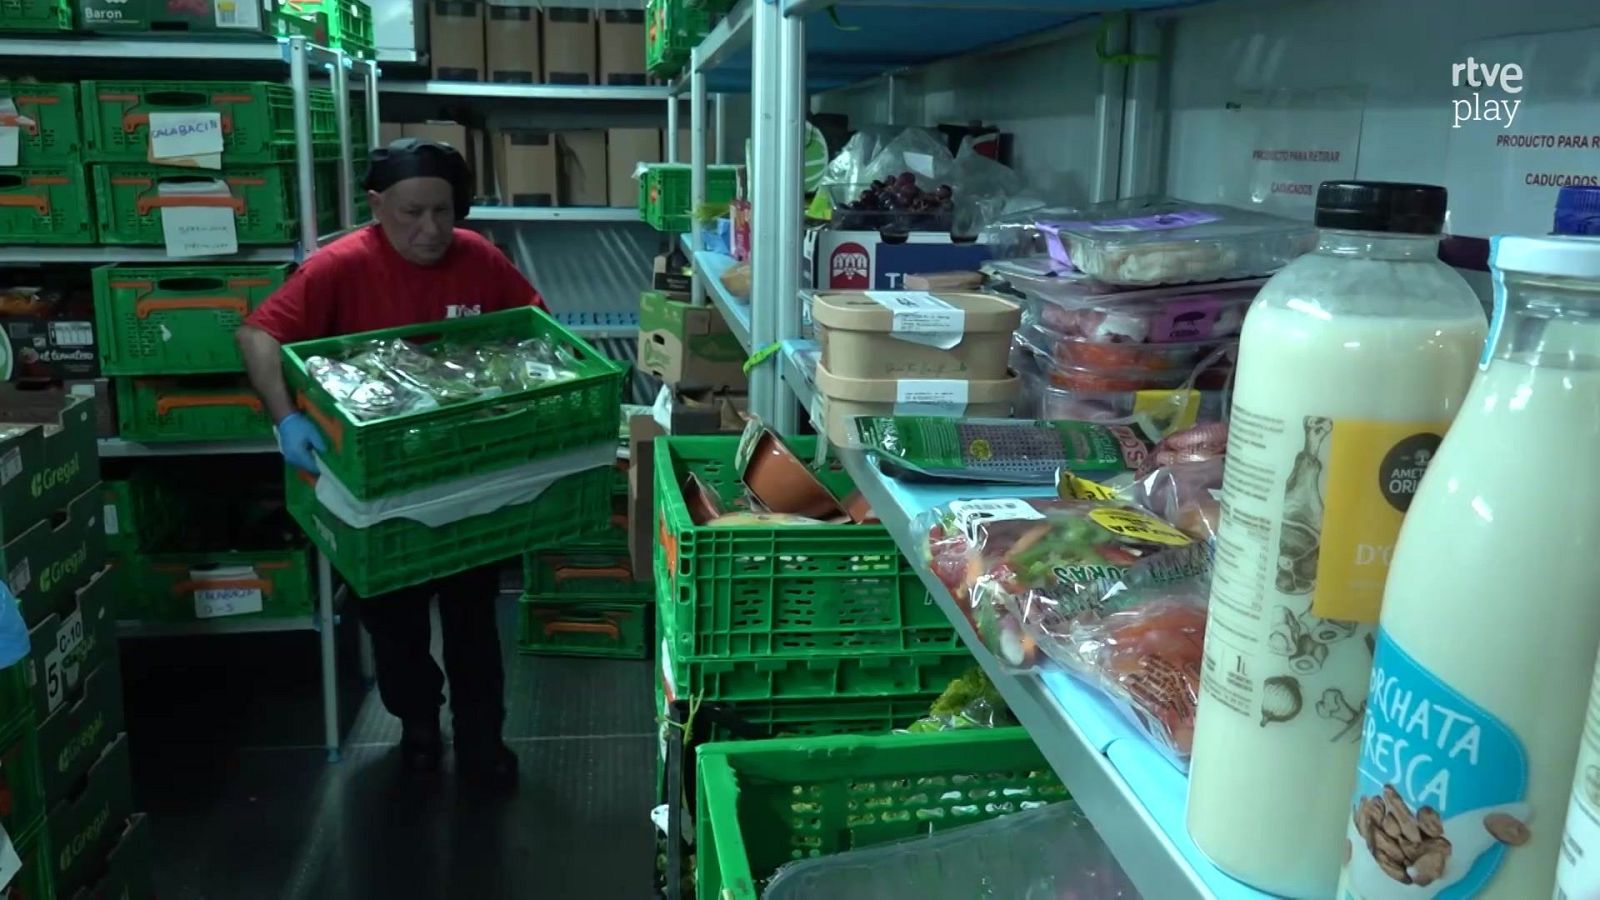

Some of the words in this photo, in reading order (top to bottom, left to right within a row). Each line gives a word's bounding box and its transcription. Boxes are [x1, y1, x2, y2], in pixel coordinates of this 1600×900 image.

[84, 7, 122, 19] Baron
[1496, 134, 1555, 148] PRODUCTO
[1557, 135, 1589, 148] PARA
[1525, 173, 1598, 187] CADUCADOS
[43, 453, 80, 488] Gregal
[47, 664, 60, 698] 5
